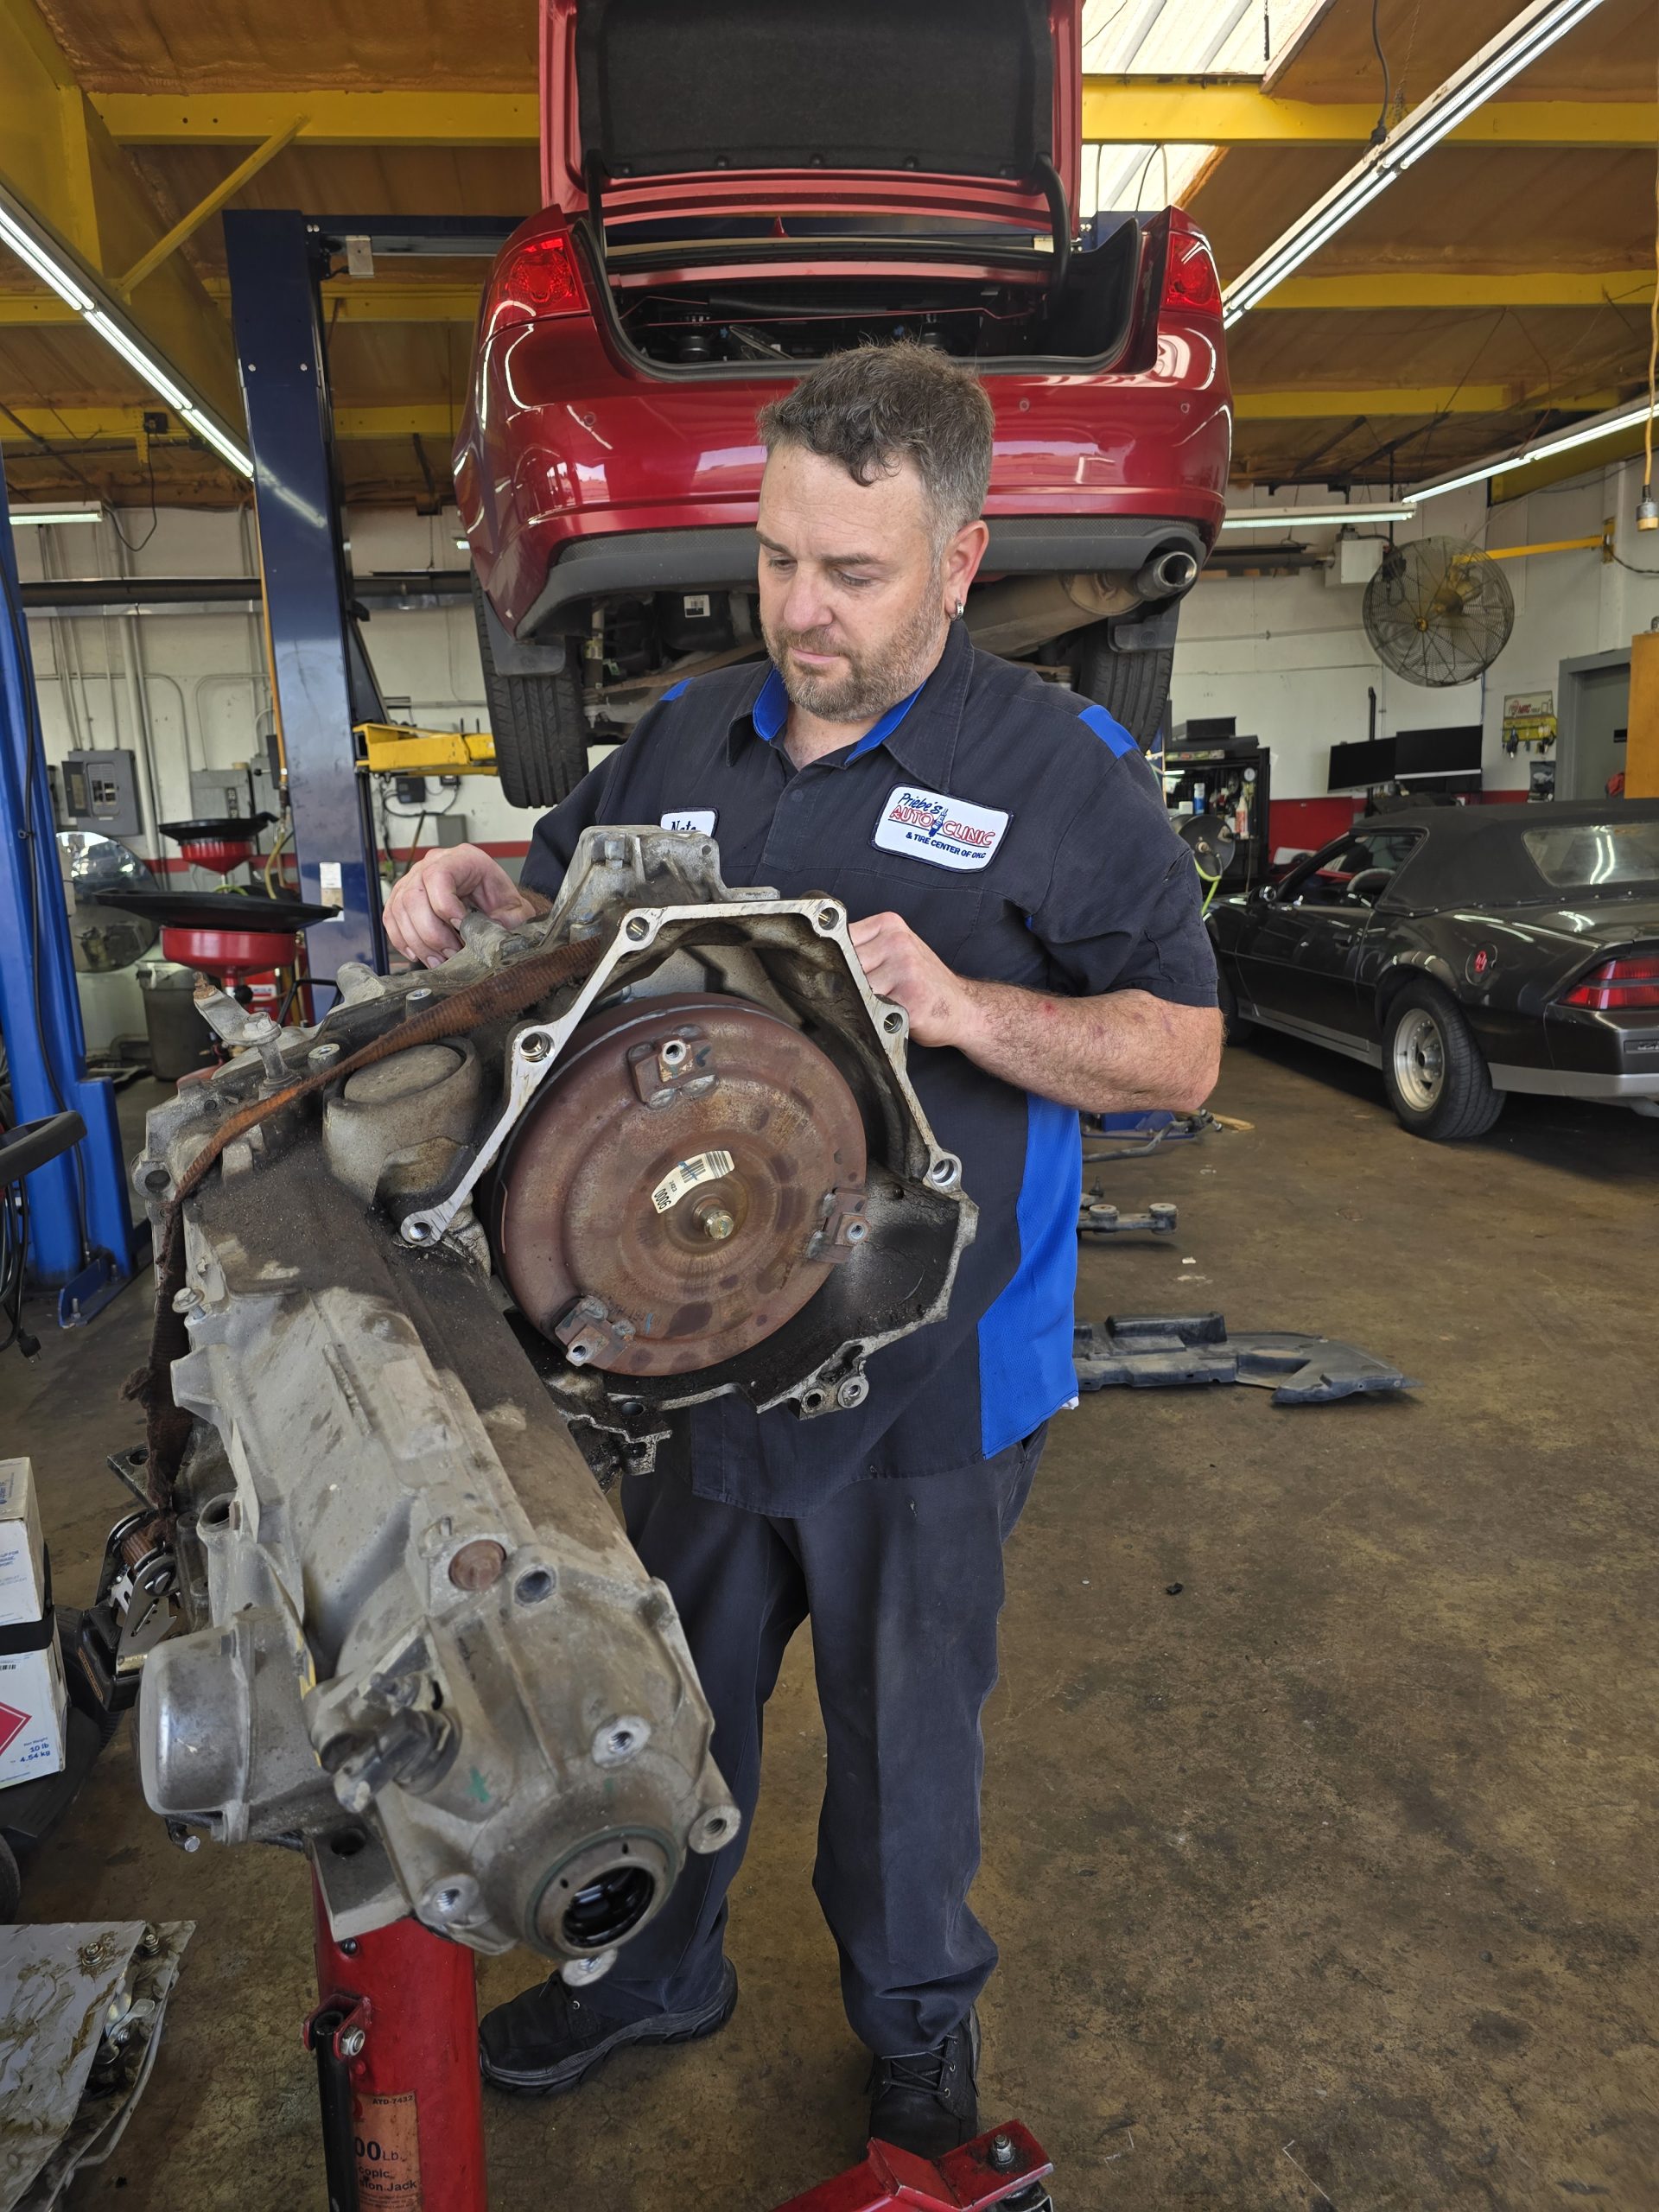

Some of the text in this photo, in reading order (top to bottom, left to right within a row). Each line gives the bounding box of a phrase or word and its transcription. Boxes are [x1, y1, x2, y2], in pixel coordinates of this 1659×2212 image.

[897, 792, 943, 815] Priebe's
[888, 804, 996, 847] AUTO CLINIC
[914, 834, 930, 845] TIRE
[931, 837, 961, 855] CENTER
[961, 849, 972, 858] OF
[653, 1188, 671, 1210] 0006
[20, 1753, 39, 1762] 4.54
[372, 2094, 413, 2105] ATD-7432
[386, 2179, 416, 2192] Jack
